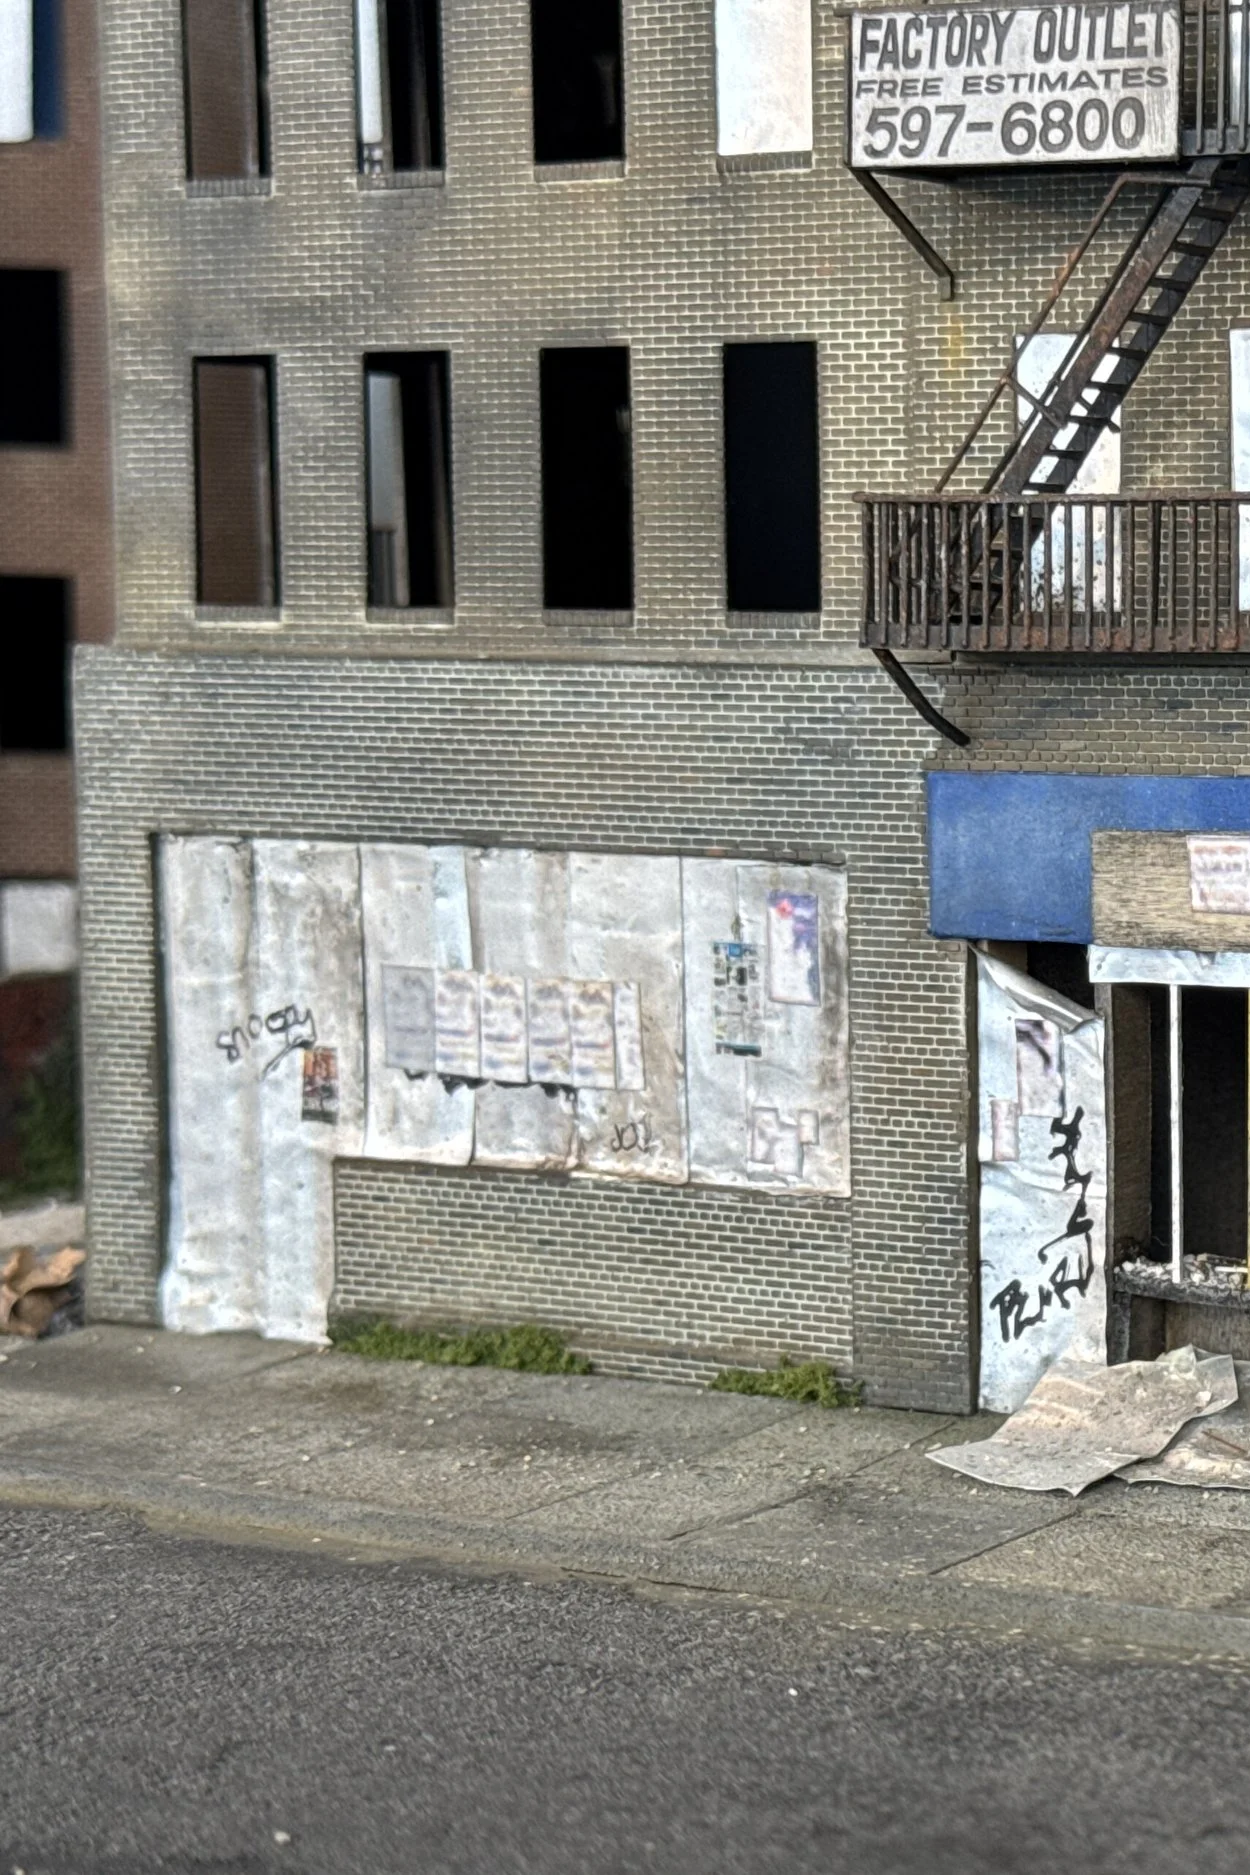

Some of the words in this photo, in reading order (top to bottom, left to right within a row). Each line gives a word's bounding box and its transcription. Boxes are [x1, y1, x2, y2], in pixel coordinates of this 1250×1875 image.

[858, 11, 1018, 71] FACTORY
[1032, 4, 1168, 63] OUTLET
[855, 78, 944, 100] FREE
[961, 66, 1169, 96] ESTIMATES
[862, 96, 1146, 159] 597-6800
